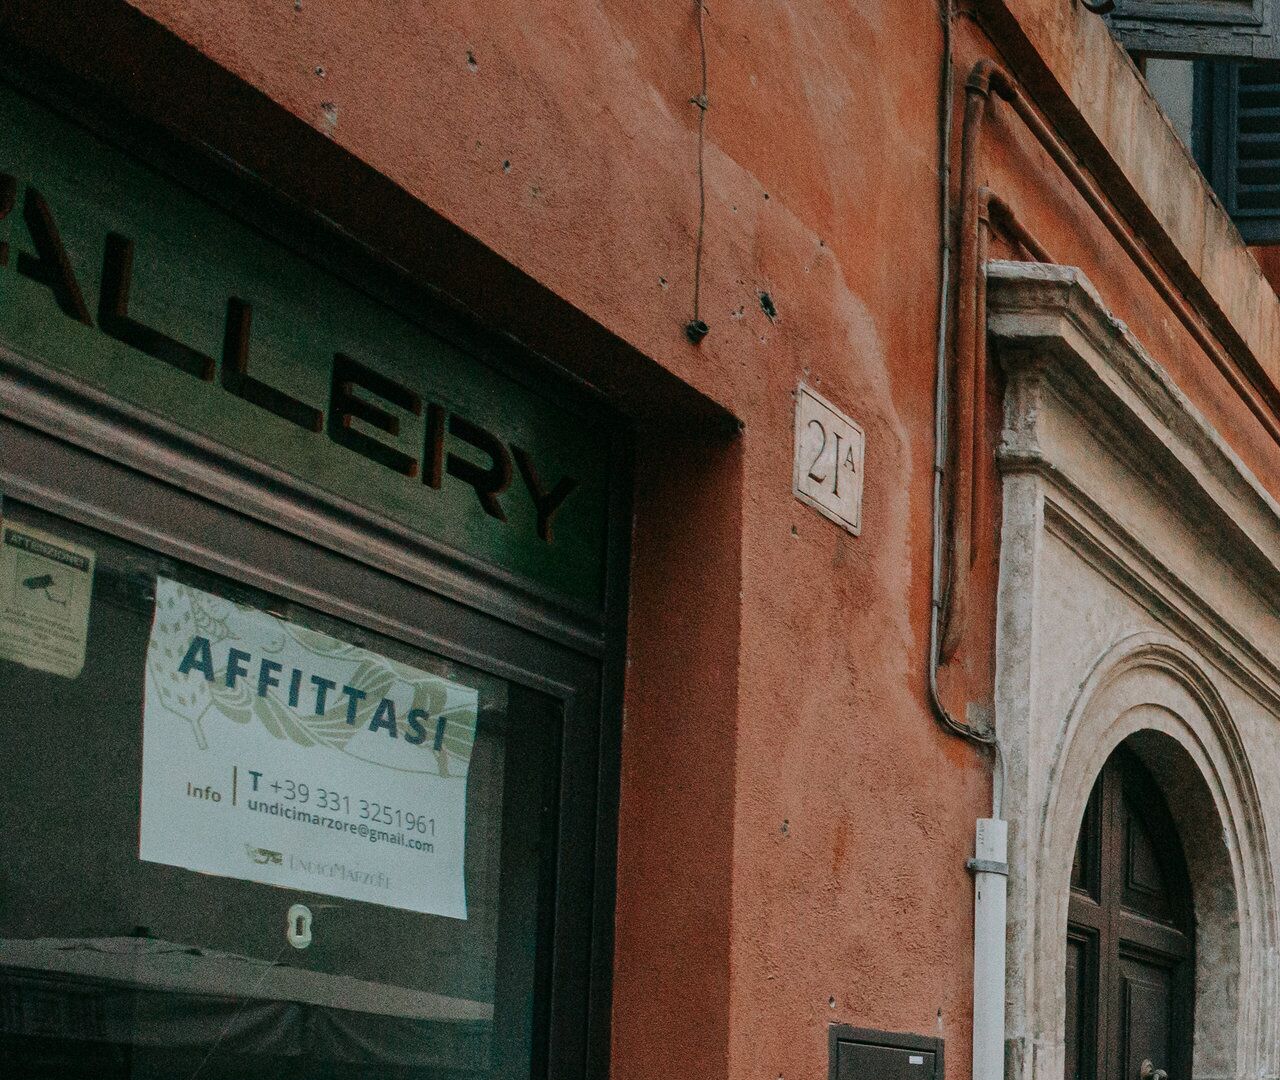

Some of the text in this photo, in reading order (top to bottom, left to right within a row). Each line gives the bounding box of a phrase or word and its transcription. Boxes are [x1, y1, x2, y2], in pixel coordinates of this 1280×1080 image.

[0, 172, 580, 545] ALLERY
[177, 635, 447, 752] AFFITTASI
[186, 781, 222, 804] Info
[247, 798, 436, 854] undicimarzore@gmail.com
[248, 770, 437, 837] T +39 331 3251961
